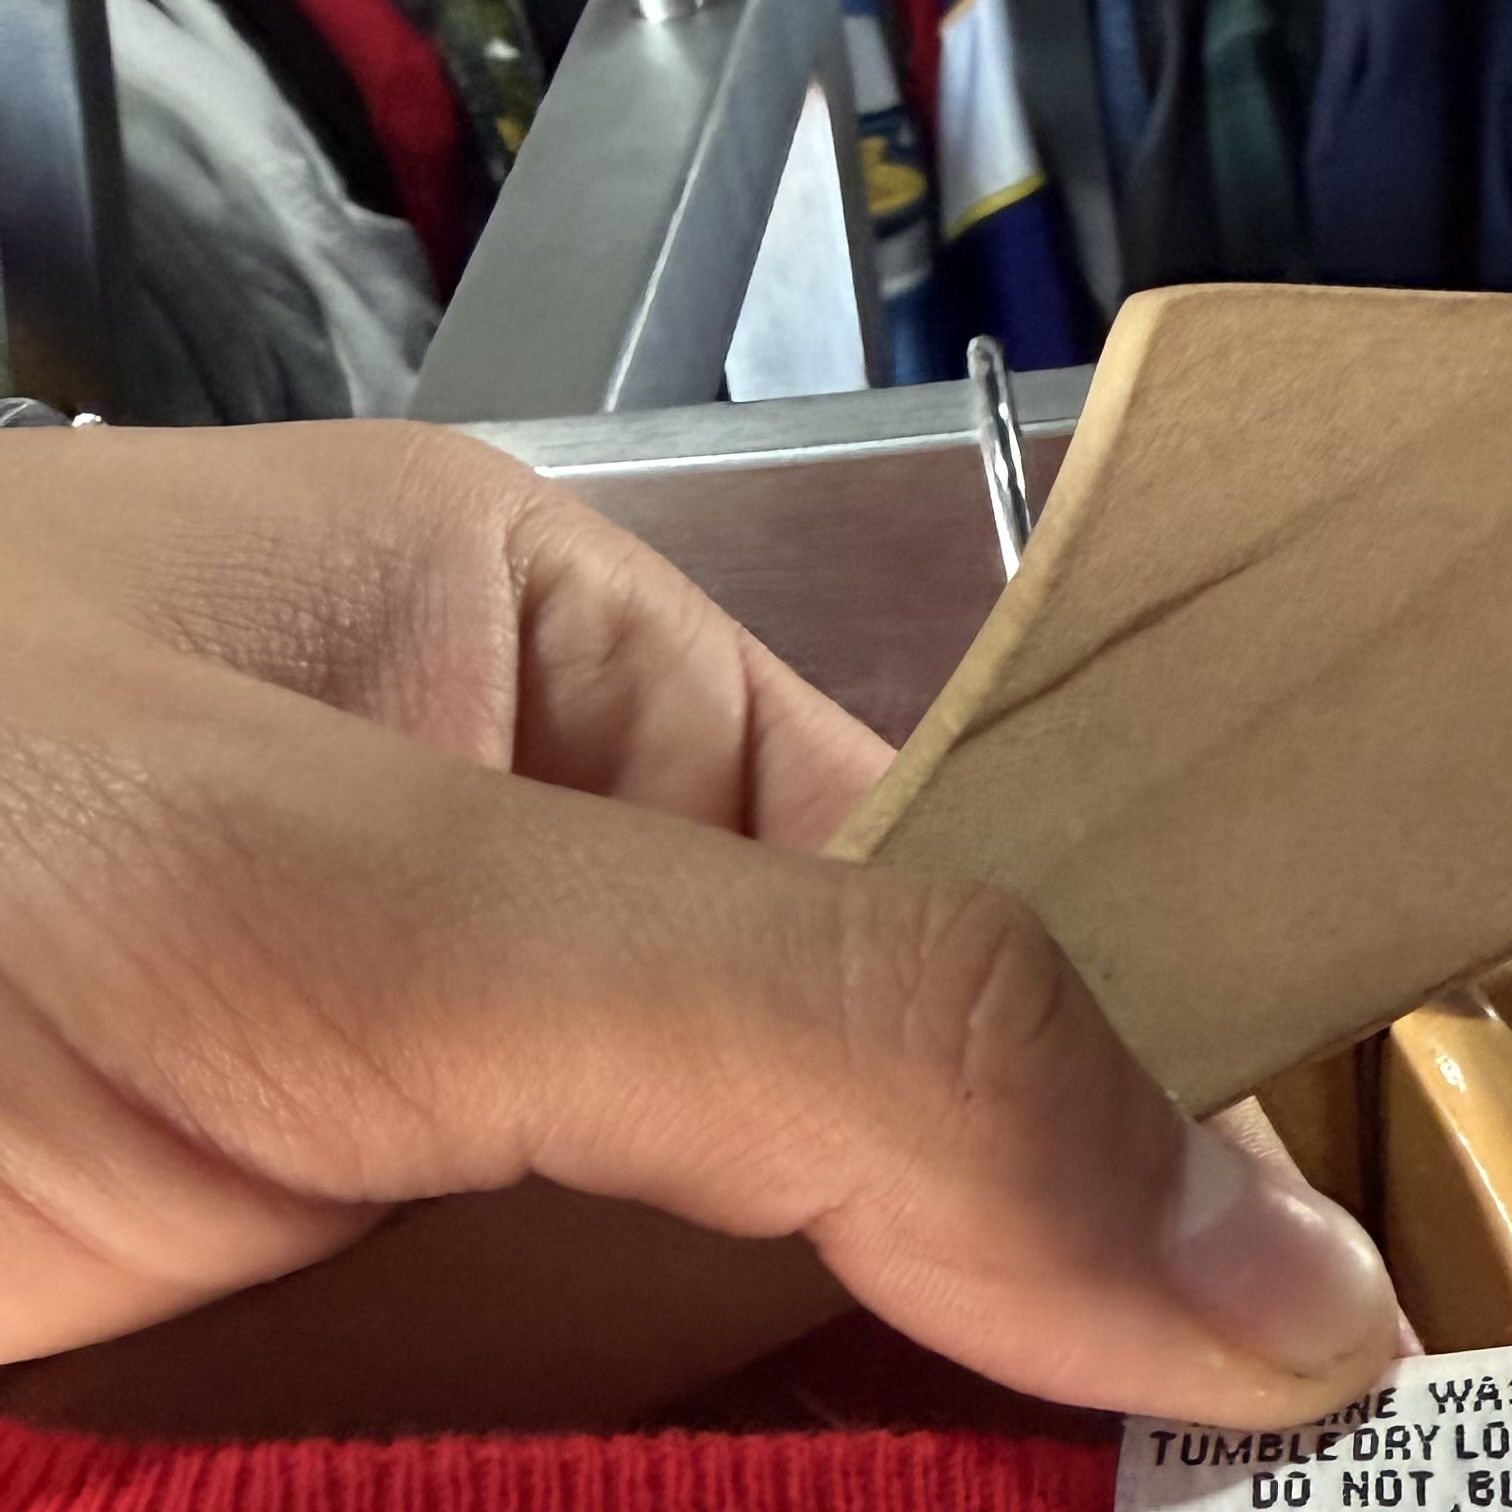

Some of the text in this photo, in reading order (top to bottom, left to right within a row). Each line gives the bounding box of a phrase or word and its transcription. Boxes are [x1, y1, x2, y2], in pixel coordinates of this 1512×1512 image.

[1150, 1430, 1343, 1467] TUMBLE
[1352, 1424, 1440, 1462] DRY
[1251, 1470, 1311, 1509] DO
[1342, 1469, 1434, 1508] NOT
